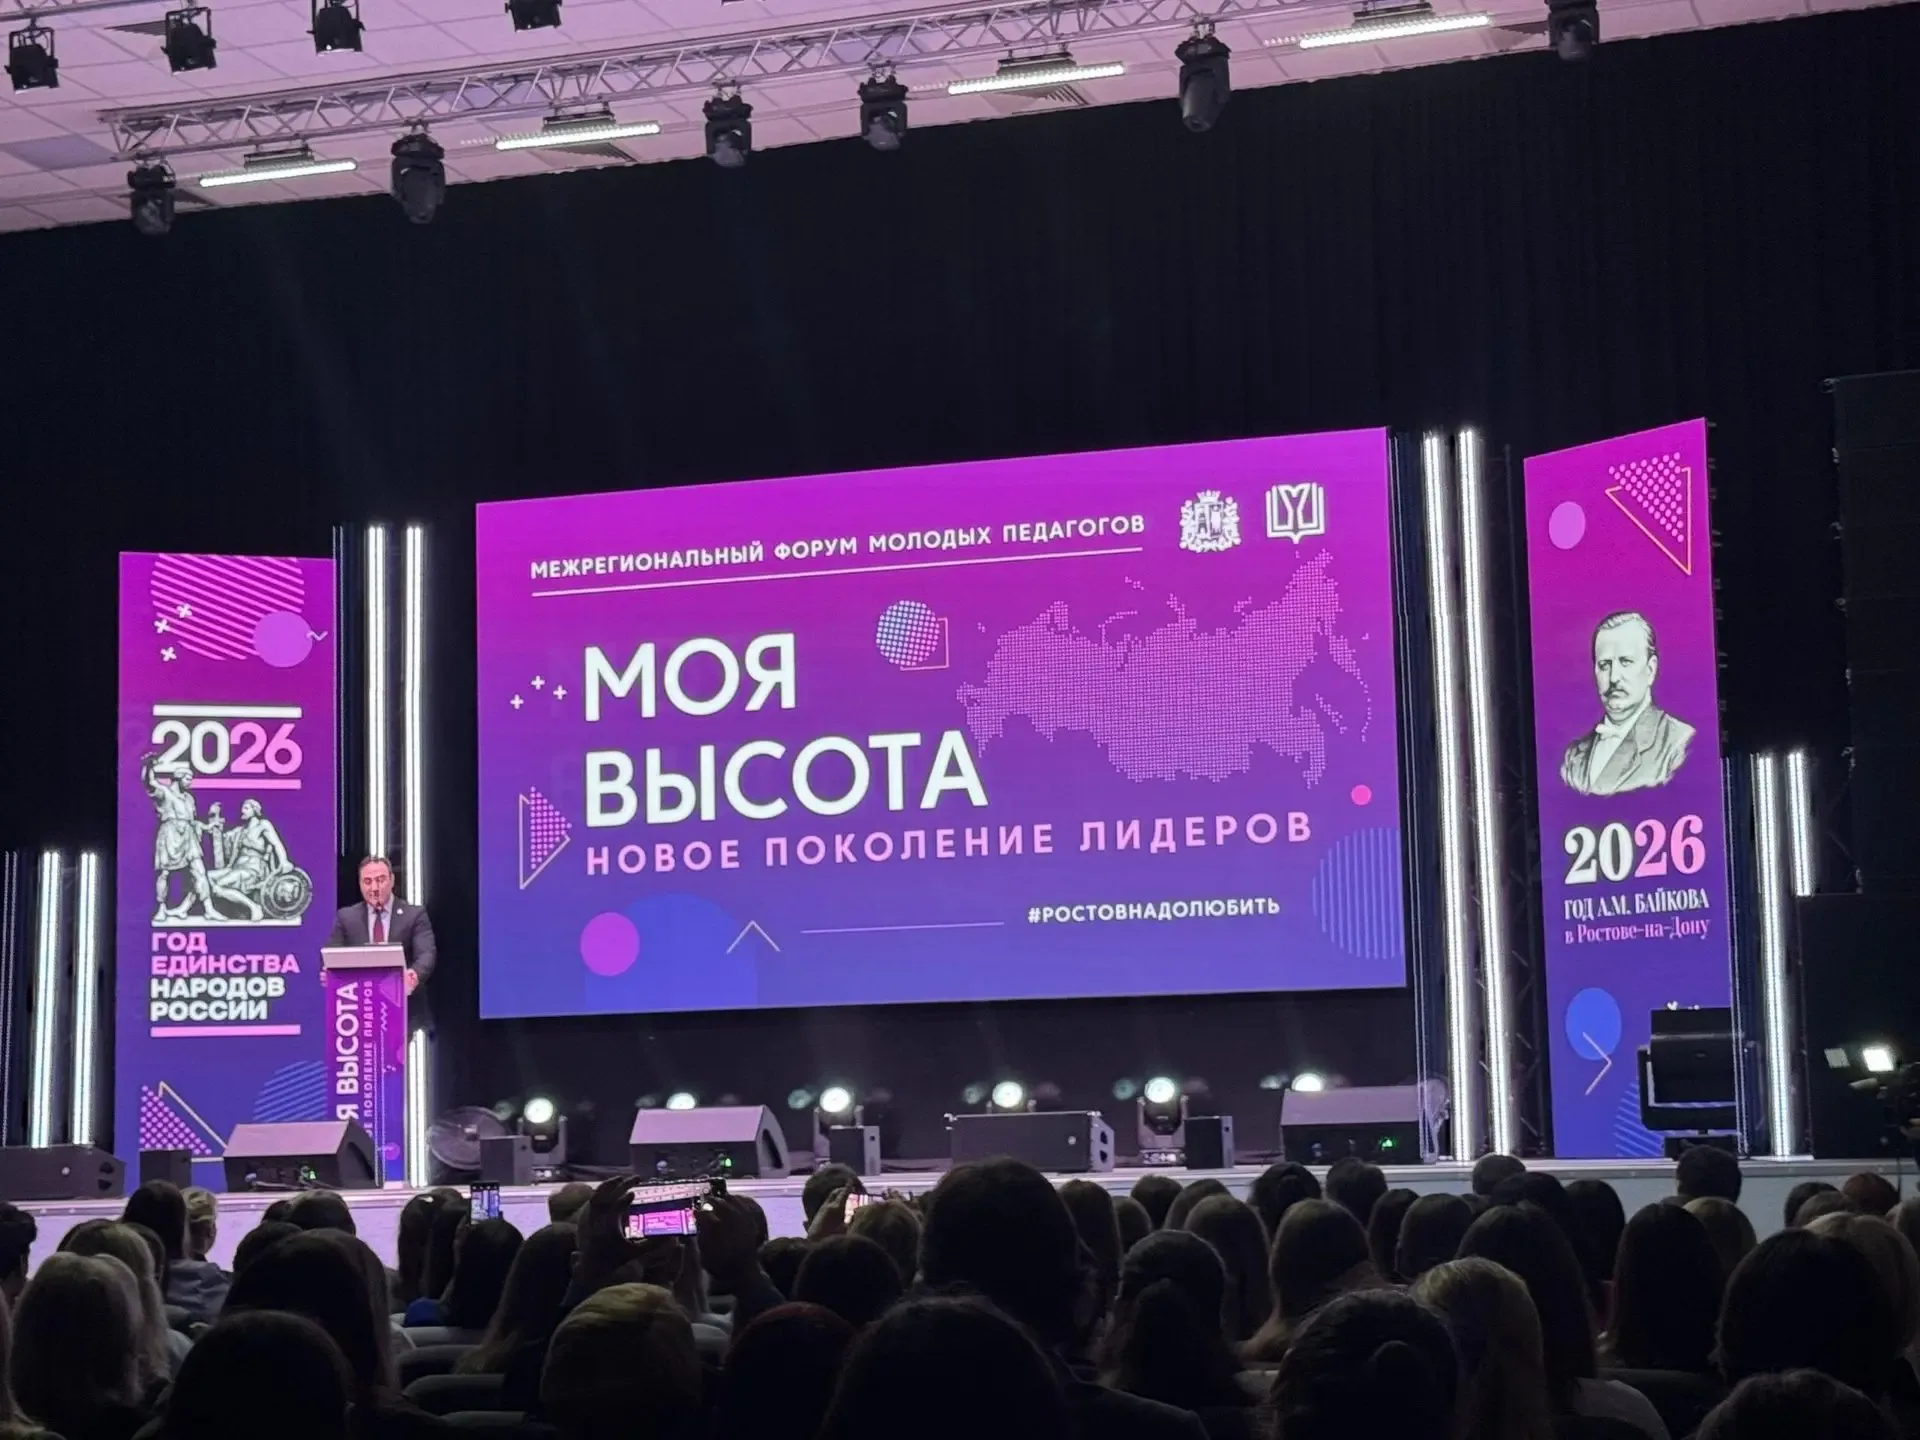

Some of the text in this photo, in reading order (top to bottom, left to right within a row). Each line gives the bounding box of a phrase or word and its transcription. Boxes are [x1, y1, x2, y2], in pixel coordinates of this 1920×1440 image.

[530, 514, 1145, 579] МЕЖРЕГИОНАЛЬНЫЙ ФОРУМ МОЛОДЫХ ПЕДАГОГОВ
[584, 632, 796, 722] МОЯ
[151, 720, 302, 774] 2026
[585, 730, 989, 827] ВЫСОТА
[587, 811, 1311, 876] НОВОЕ ПОКОЛЕНИЕ ЛИДЕРОВ
[1564, 814, 1706, 885] 2026
[1027, 897, 1280, 924] #РОСТОВНАДОЛЮБИТЬ
[1564, 887, 1710, 922] ГОД А.М. БАЙКОВА
[1565, 915, 1710, 944] в Ростове-на-Дону
[151, 954, 300, 977] ЕДИНСТВА
[152, 932, 208, 954] ГОД
[150, 976, 286, 1000] НАРОДОВ
[150, 999, 268, 1022] РОССИИ
[363, 980, 373, 1037] ЛИДЕРОВ
[336, 981, 359, 1095] ВЫСОТА
[363, 1042, 373, 1118] ПОКОЛЕНИЕ
